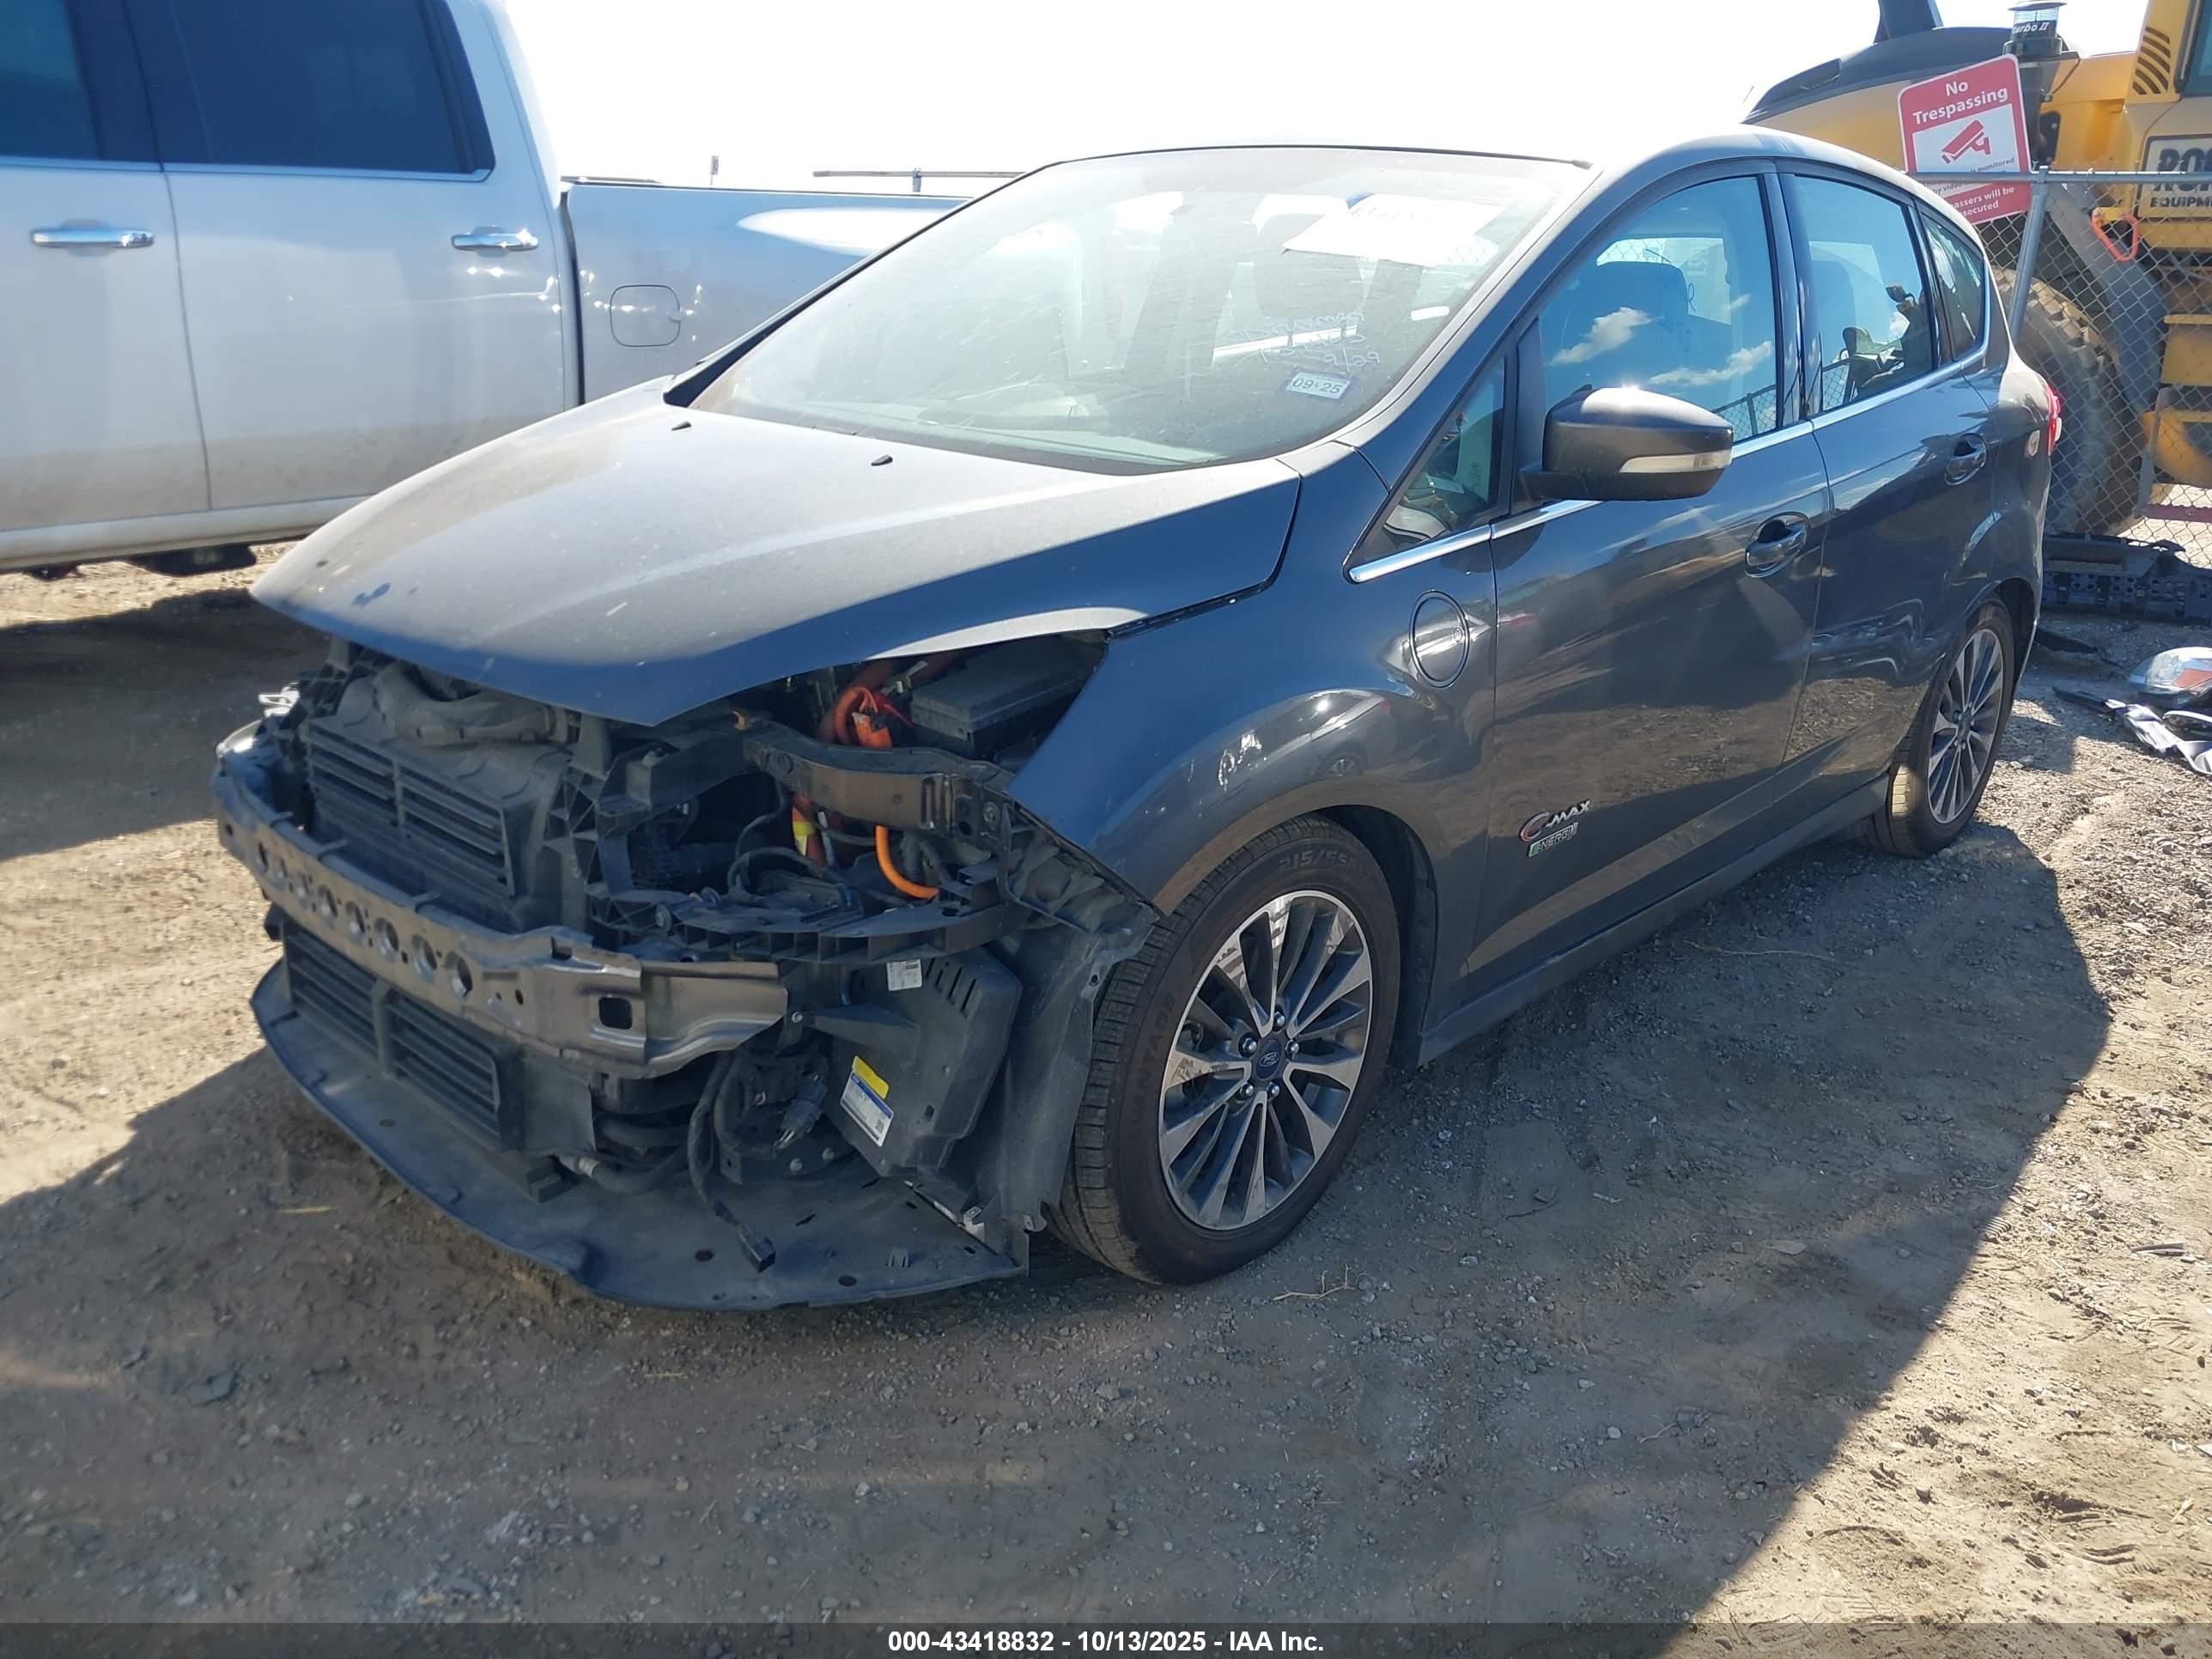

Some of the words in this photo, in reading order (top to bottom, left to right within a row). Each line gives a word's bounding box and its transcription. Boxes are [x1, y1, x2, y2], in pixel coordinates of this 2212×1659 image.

[1945, 81, 1969, 97] No
[1912, 88, 2008, 125] Trespassing
[1978, 156, 2014, 173] monitored
[1984, 188, 2001, 201] will
[2002, 185, 2014, 195] be
